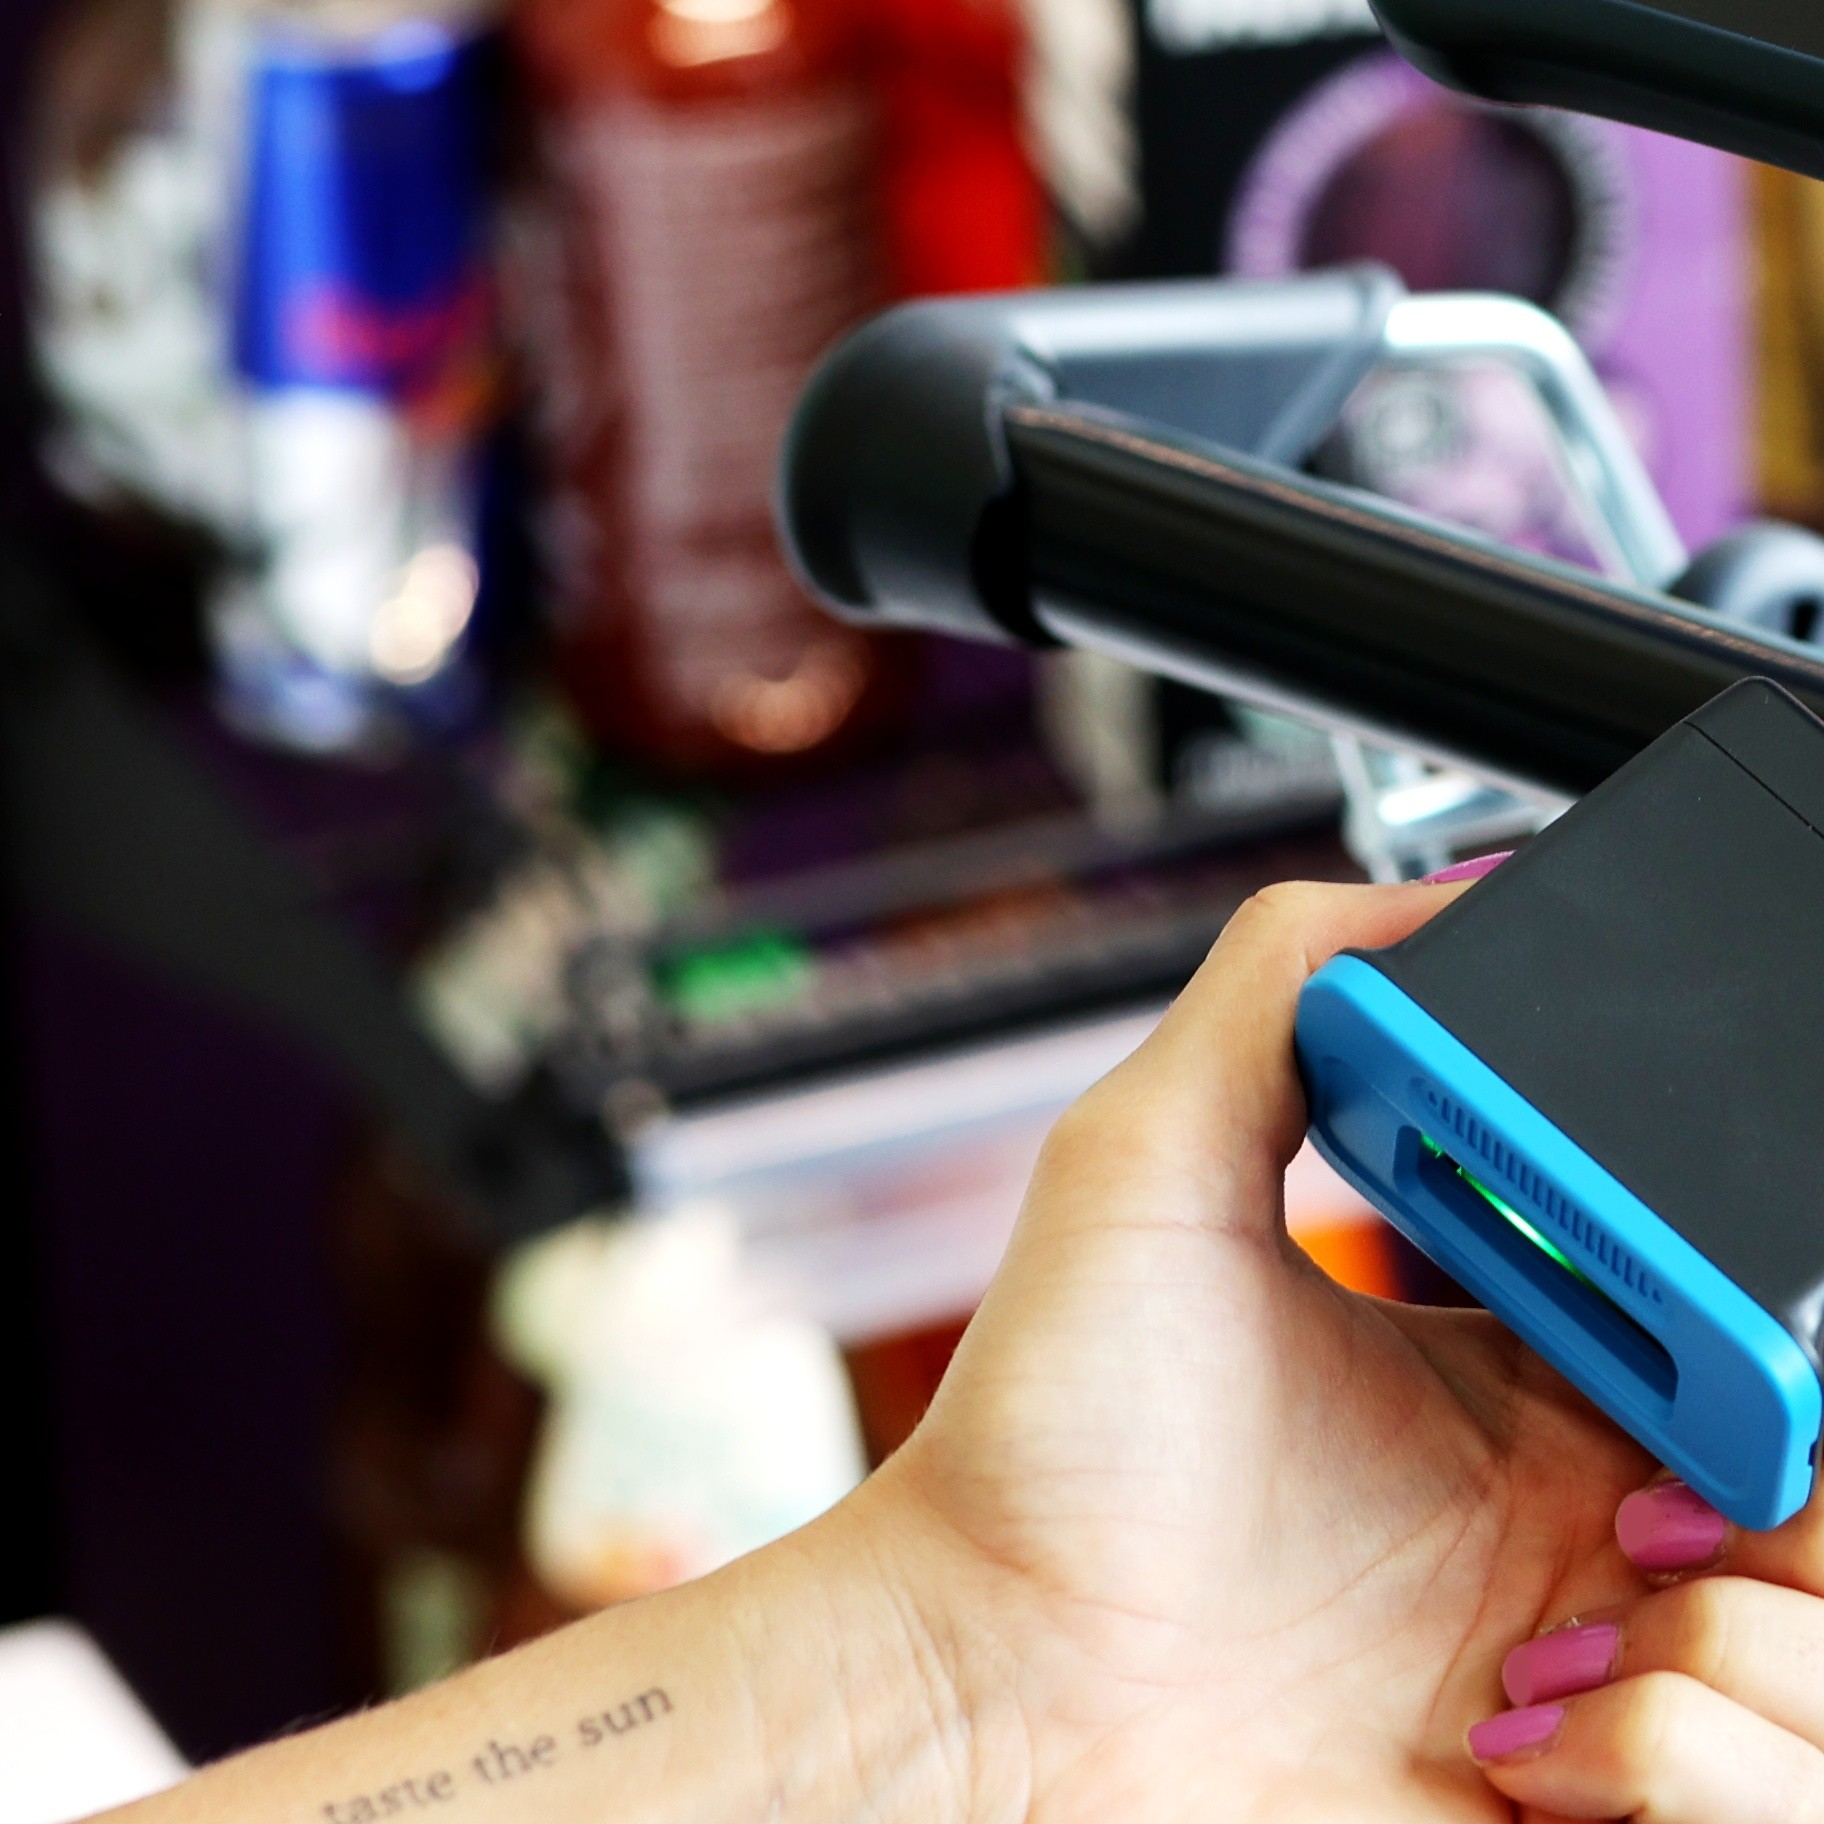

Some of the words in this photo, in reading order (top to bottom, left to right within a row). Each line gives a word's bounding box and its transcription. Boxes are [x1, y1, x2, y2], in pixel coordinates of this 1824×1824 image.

[322, 1769, 455, 1824] taste
[472, 1734, 558, 1785] the
[576, 1685, 674, 1747] sun
